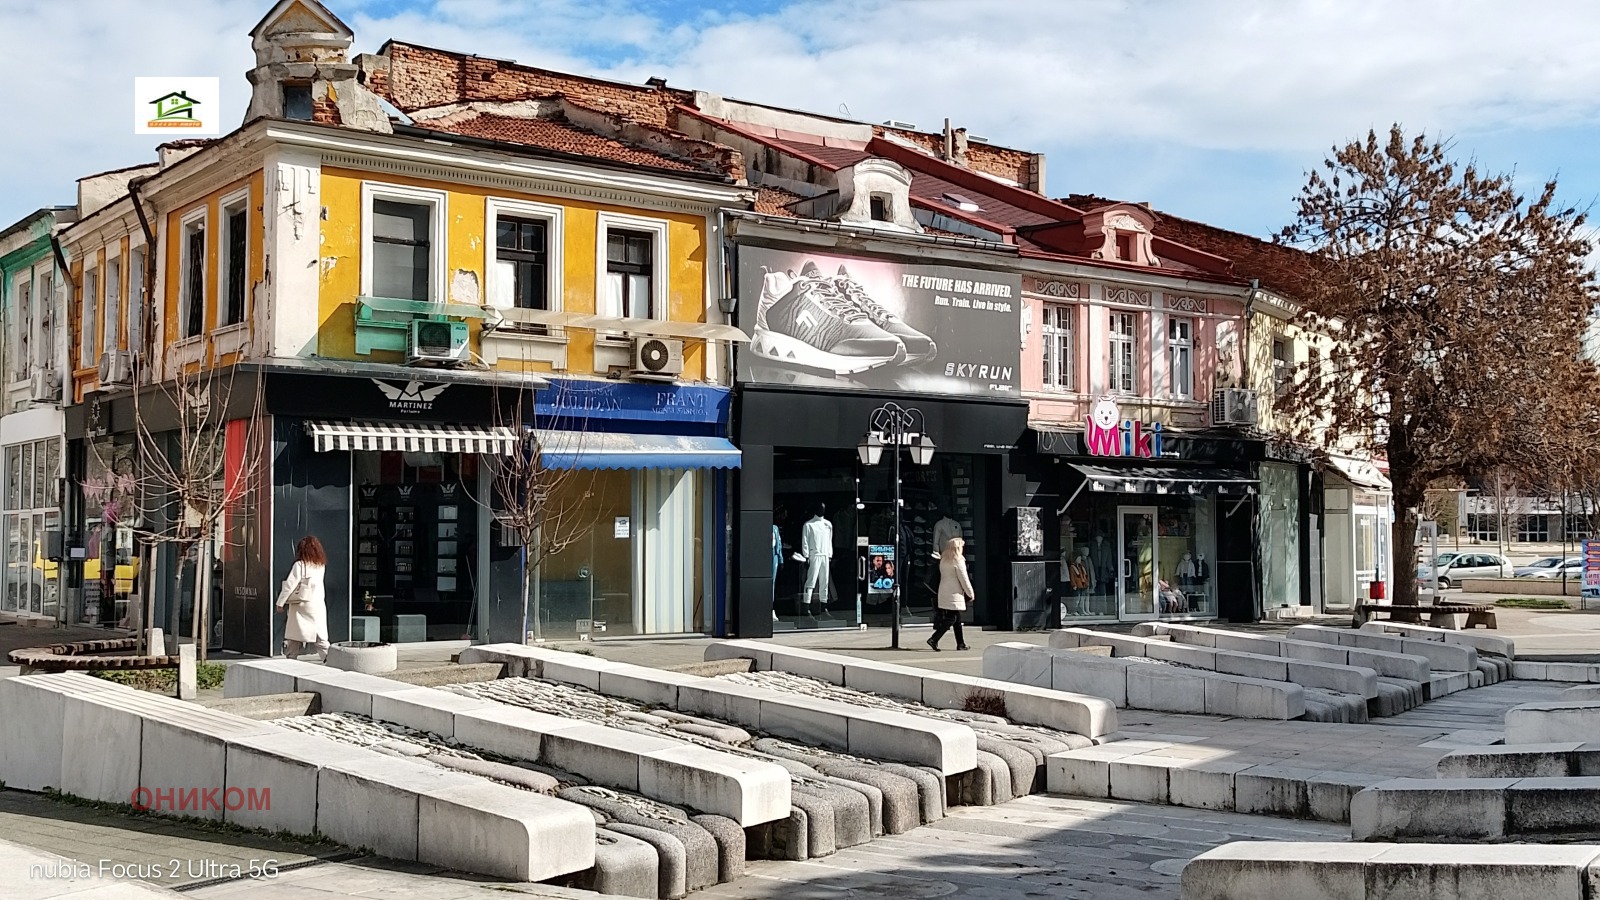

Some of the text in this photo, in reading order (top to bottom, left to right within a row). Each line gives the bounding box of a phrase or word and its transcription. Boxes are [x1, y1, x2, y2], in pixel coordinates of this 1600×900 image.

[902, 274, 1012, 298] THE FUTURE HAS ARRIVED.
[934, 295, 1012, 313] Run. Train. Live in style.
[944, 362, 1012, 381] SKYRUN
[389, 401, 433, 409] MARTINEZ
[1083, 414, 1163, 458] Miki
